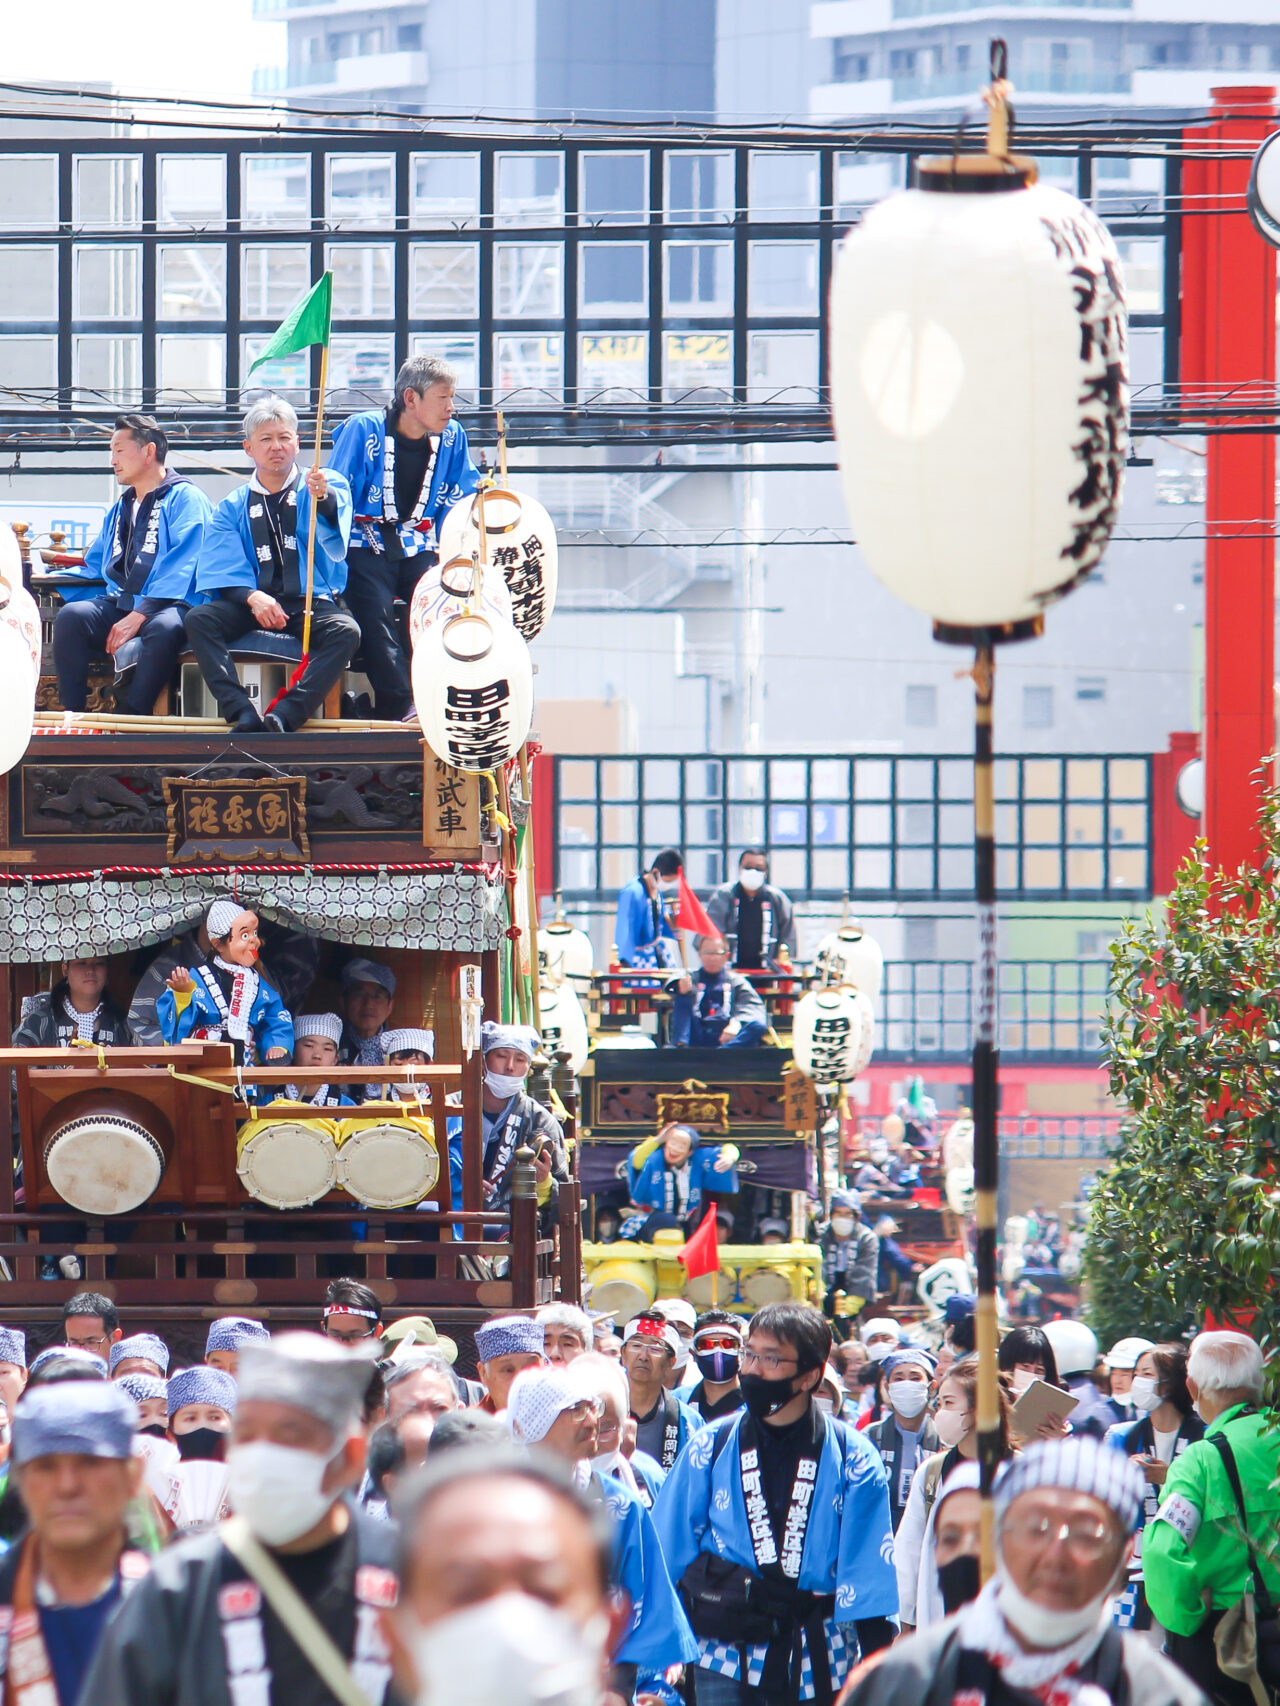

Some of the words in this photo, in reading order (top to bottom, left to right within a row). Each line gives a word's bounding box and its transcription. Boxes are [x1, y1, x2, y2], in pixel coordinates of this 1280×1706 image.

[445, 679, 511, 772] 田町学区連
[740, 1447, 778, 1567] 田町学区連
[780, 1457, 818, 1579] 田町学区連
